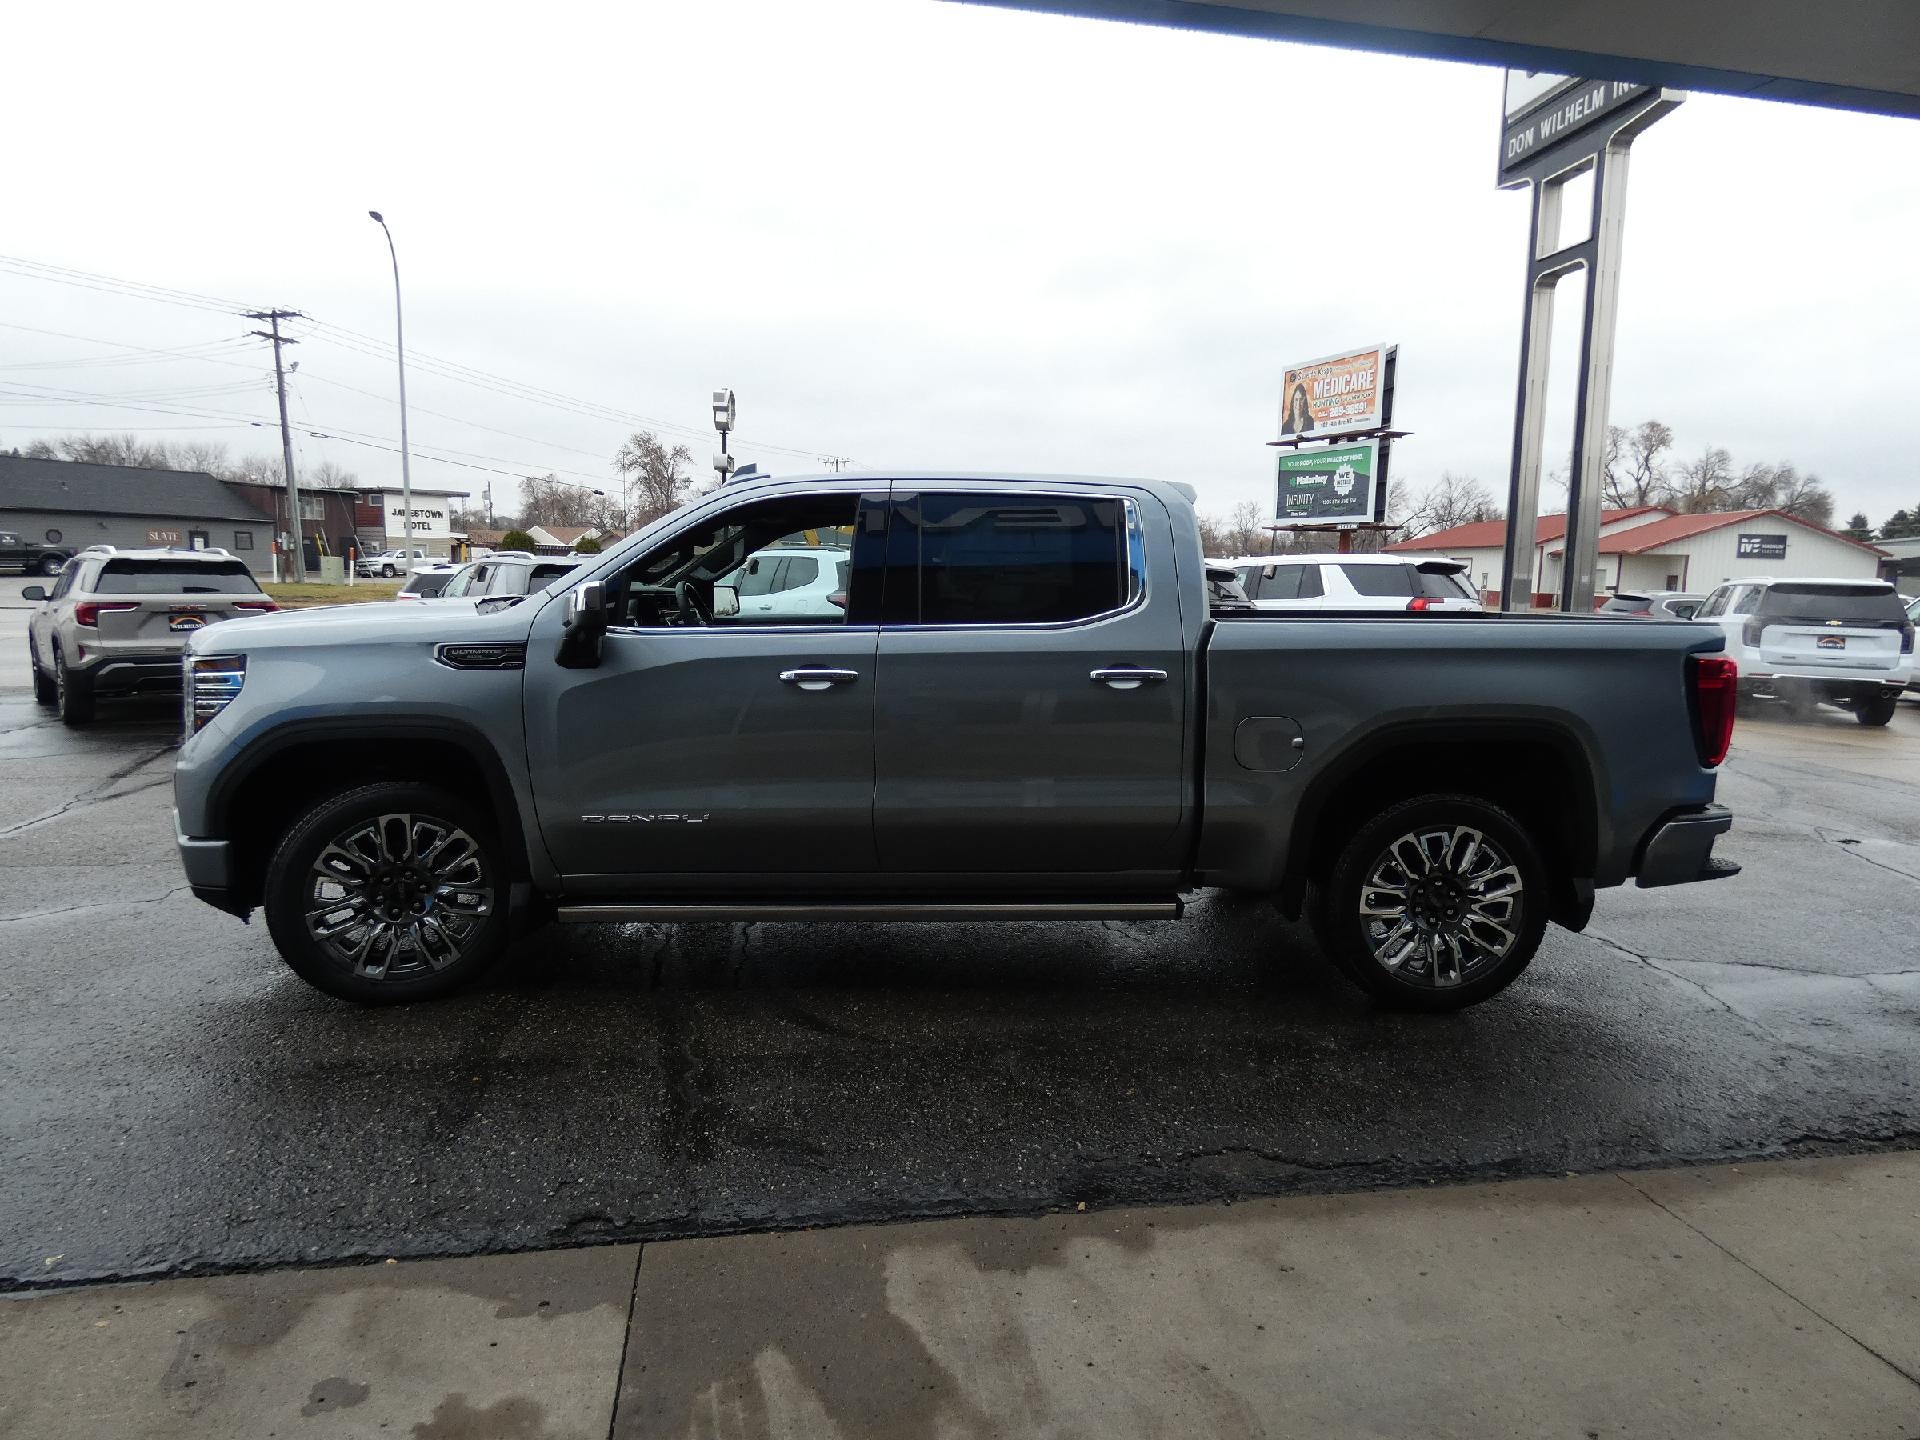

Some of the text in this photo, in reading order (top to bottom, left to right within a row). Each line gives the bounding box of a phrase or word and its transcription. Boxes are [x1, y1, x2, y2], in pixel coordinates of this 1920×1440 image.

[1508, 127, 1535, 159] DON
[1540, 86, 1605, 139] WILHELM
[1313, 369, 1375, 399] MEDICARE
[1313, 397, 1339, 408] HUNTING
[1338, 471, 1350, 479] WE
